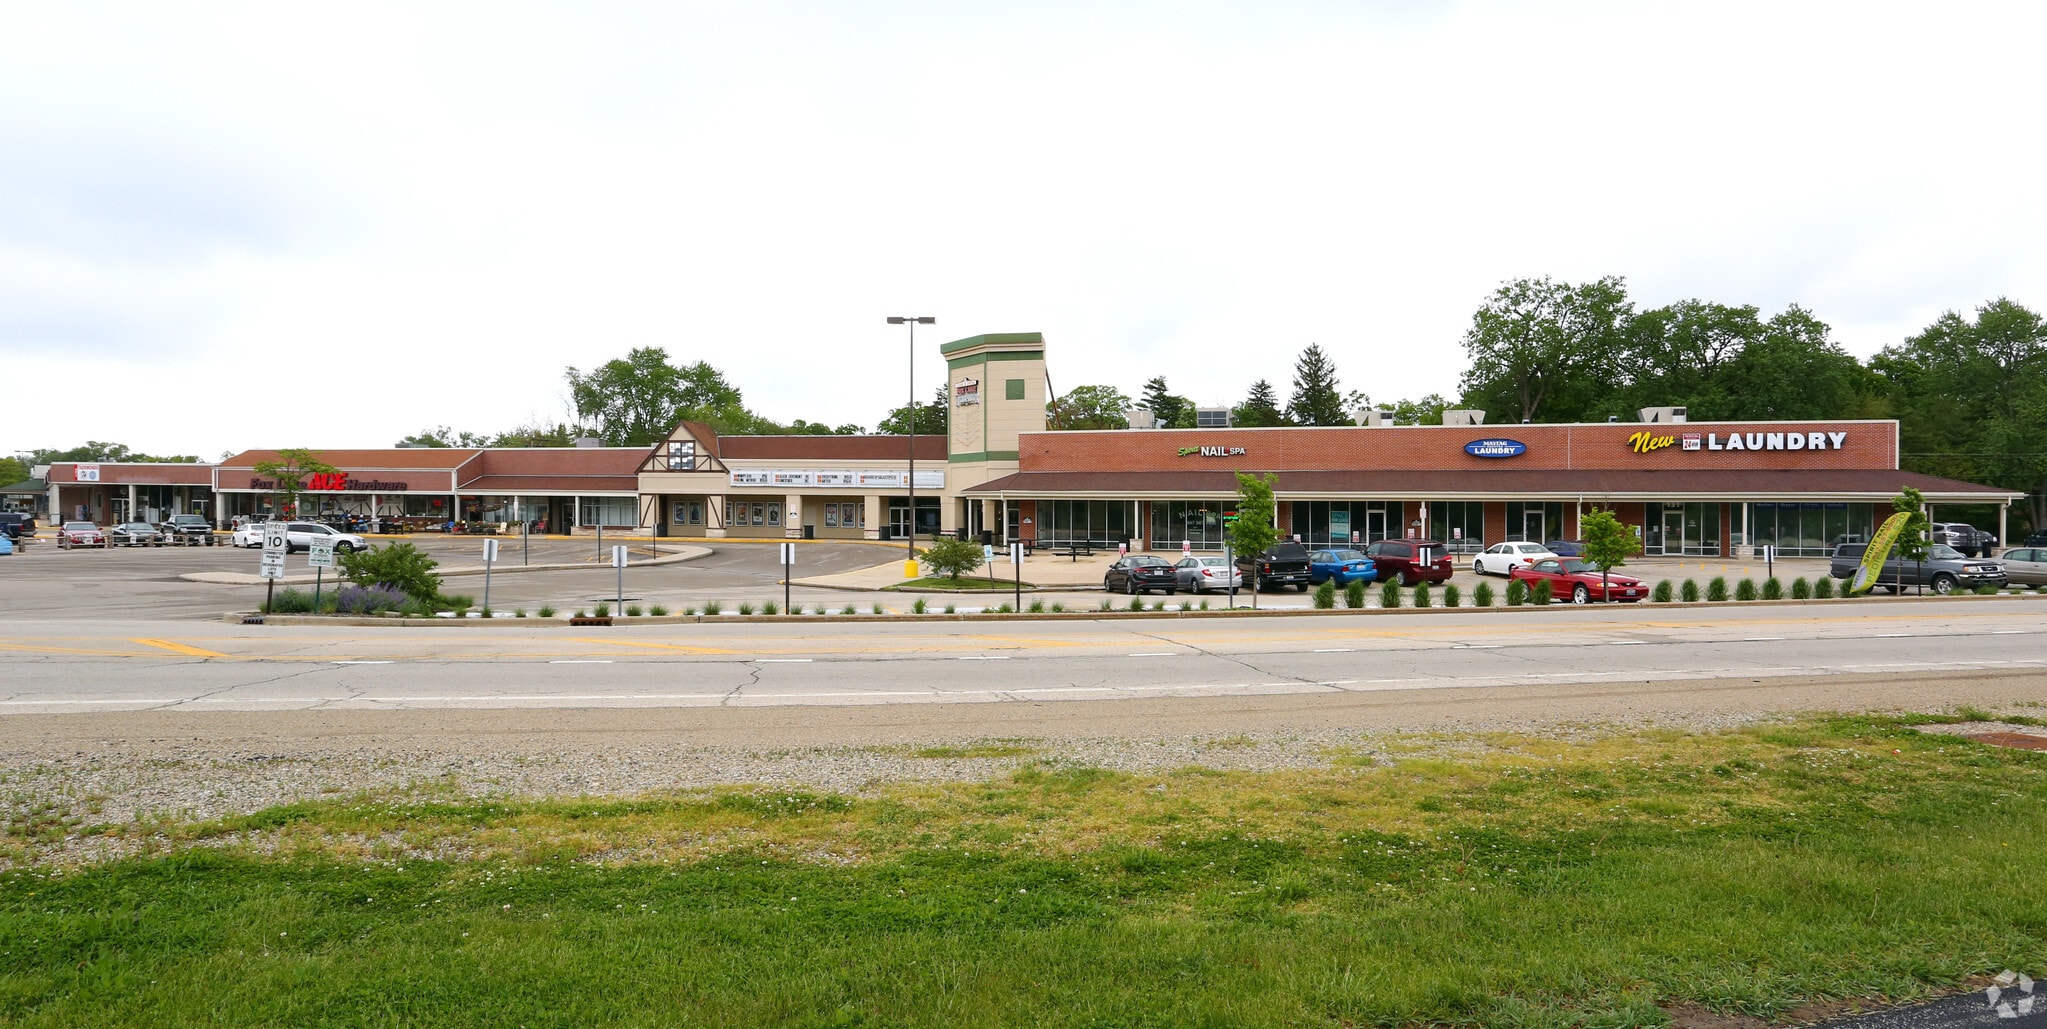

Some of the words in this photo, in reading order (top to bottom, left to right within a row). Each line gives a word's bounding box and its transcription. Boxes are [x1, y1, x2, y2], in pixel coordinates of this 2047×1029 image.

[1201, 446, 1229, 456] NAIL
[1230, 447, 1245, 455] SPA
[1628, 431, 1675, 453] New
[1708, 432, 1847, 450] LAUNDRY
[251, 478, 273, 489] Fox
[277, 478, 308, 489] Le
[308, 472, 348, 490] ACE
[346, 479, 408, 490] Hardware
[268, 536, 283, 547] 10
[1864, 540, 1878, 563] SPIRIT
[1877, 521, 1888, 538] NAIL
[1867, 533, 1894, 583] PEDICURE
